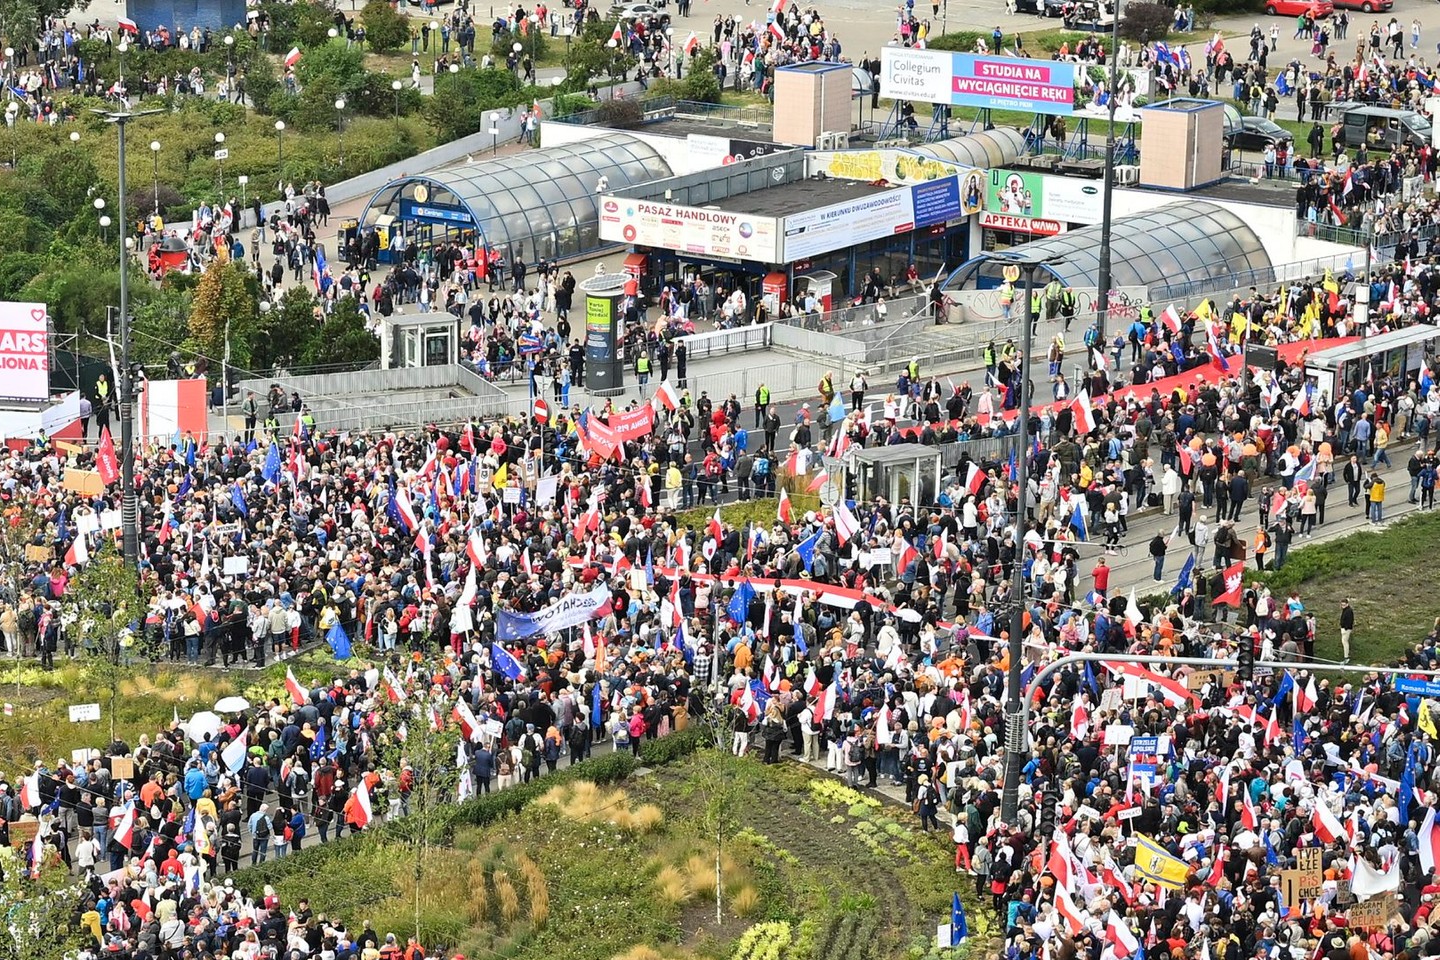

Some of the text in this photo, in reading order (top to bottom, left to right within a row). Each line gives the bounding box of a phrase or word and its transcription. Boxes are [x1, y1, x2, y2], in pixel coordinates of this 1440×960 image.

[893, 59, 941, 75] Collegium
[982, 64, 1041, 80] STUDIA NA
[893, 74, 925, 87] Civitas
[958, 80, 1067, 100] WYCIĄGNIĘCIE RĘKI
[638, 204, 737, 225] PASAŻ HANDLOWY
[984, 214, 1059, 232] APTEKA WAWA
[1401, 684, 1425, 693] Romana
[1299, 848, 1320, 860] TVP
[1298, 887, 1320, 898] CHCE
[1351, 901, 1383, 912] PROGRAM
